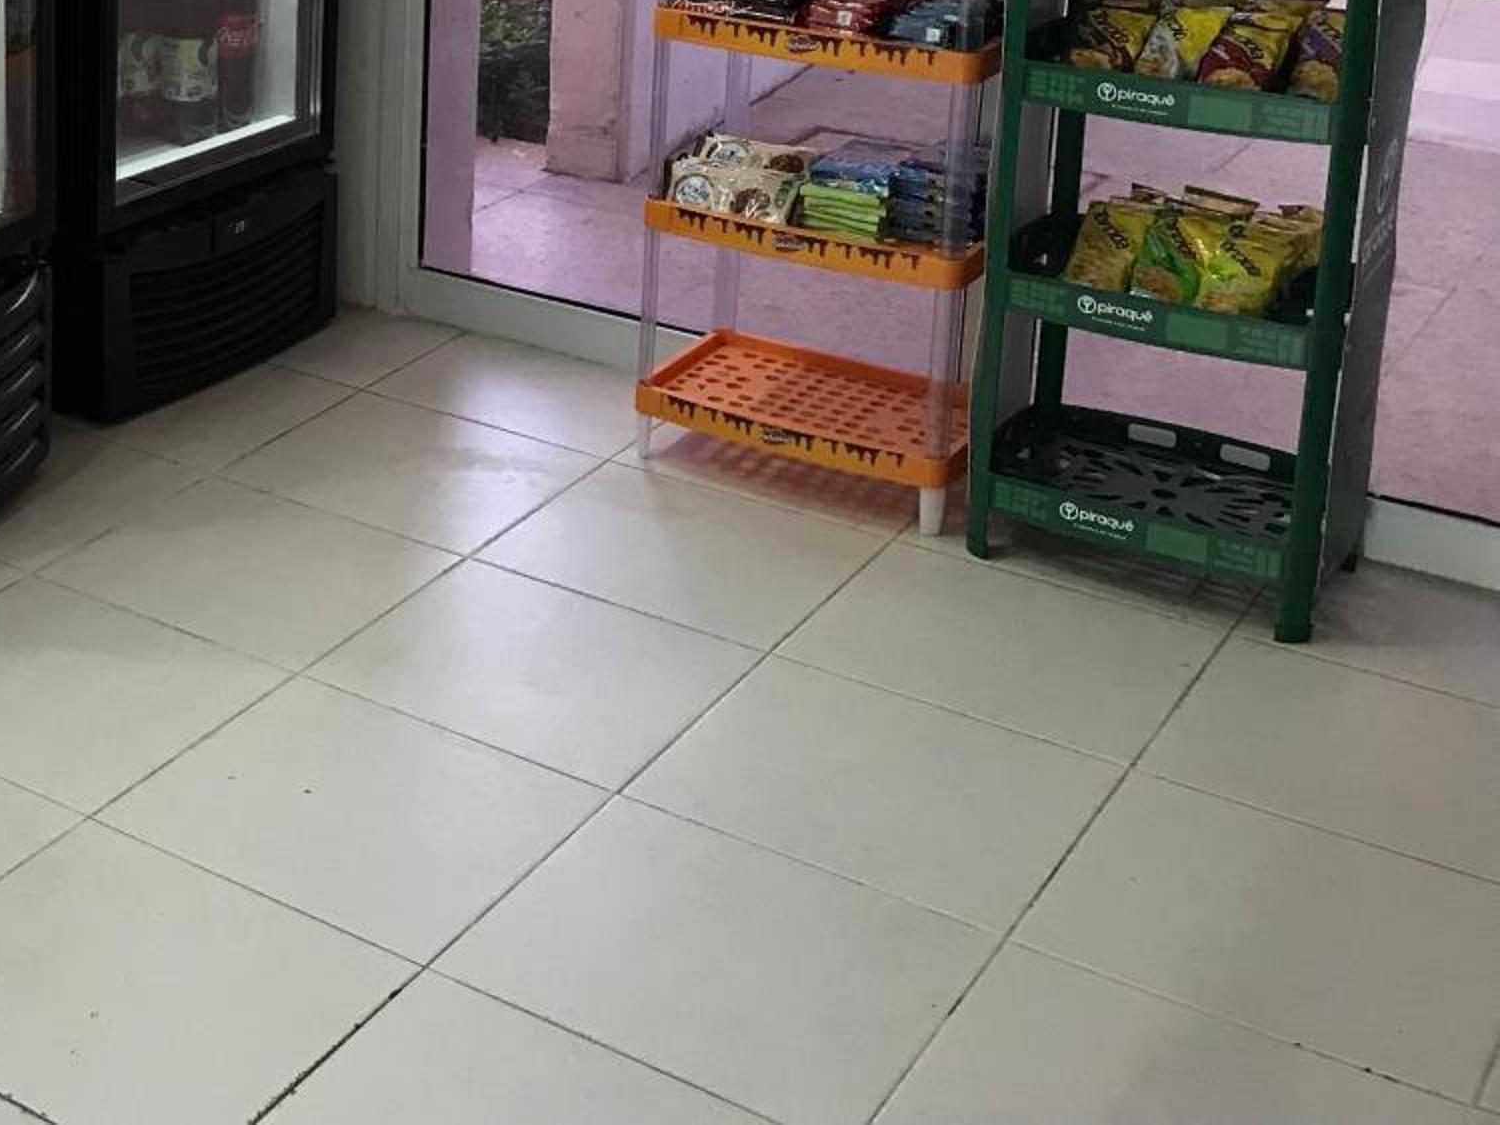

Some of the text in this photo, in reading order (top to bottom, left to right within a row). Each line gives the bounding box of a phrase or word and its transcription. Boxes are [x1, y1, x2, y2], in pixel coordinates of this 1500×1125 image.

[1116, 87, 1176, 109] piraquê
[1097, 301, 1154, 326] piraquê
[1077, 507, 1137, 535] piraquê
